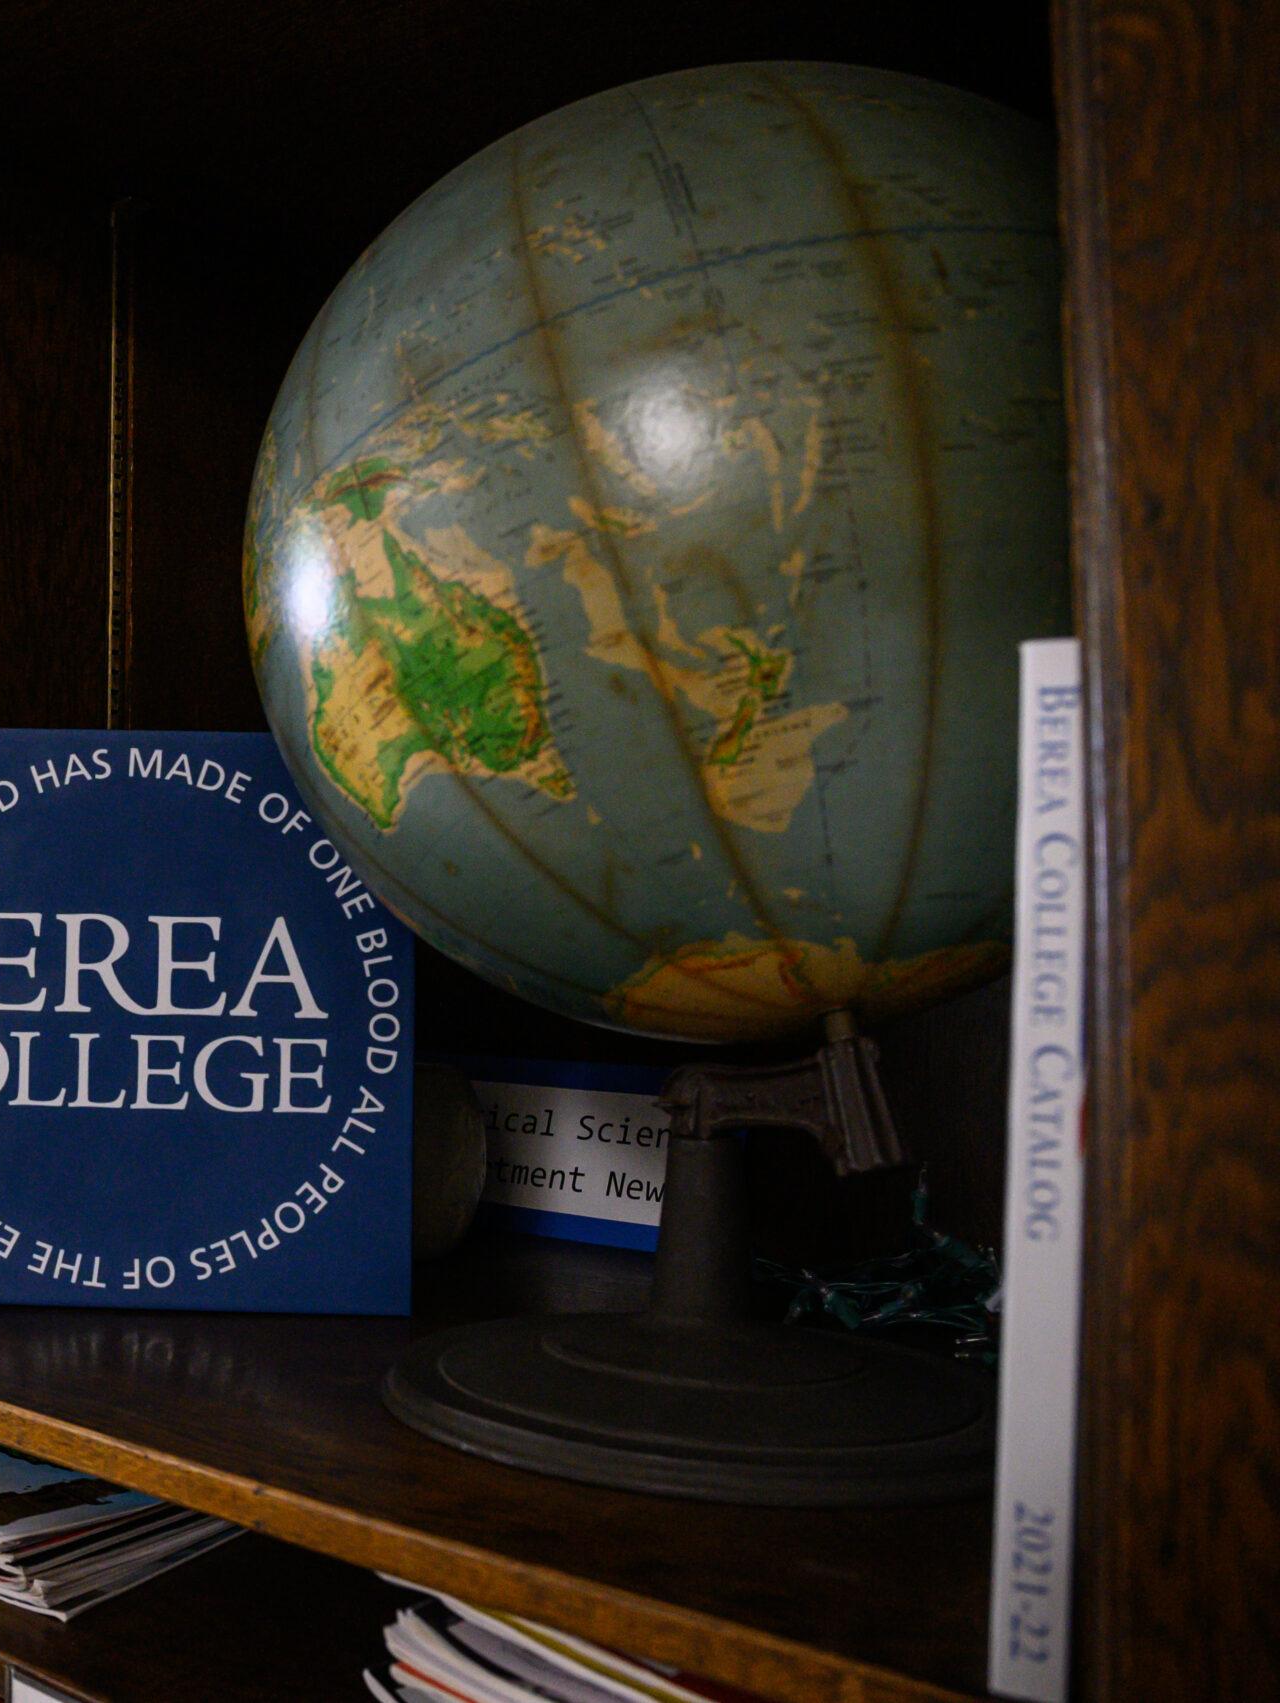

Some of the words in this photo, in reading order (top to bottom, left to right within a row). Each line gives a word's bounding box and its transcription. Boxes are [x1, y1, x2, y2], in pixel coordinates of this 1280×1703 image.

[30, 748, 112, 794] HAS
[128, 747, 252, 804] MADE
[1036, 684, 1079, 814] BEREA
[258, 792, 312, 835] OF
[308, 839, 375, 920] ONE
[1031, 833, 1078, 1031] COLLEGE
[355, 927, 401, 1075] BLOOD
[331, 1085, 385, 1155] ALL
[478, 1104, 555, 1137] ical
[1026, 1043, 1075, 1244] CATALOG
[488, 1158, 586, 1193] tment
[605, 1170, 666, 1203] New
[189, 1162, 345, 1281] PEOPLES
[26, 1240, 107, 1289] THE
[122, 1255, 176, 1290] OF
[1009, 1502, 1055, 1664] 2021-22
